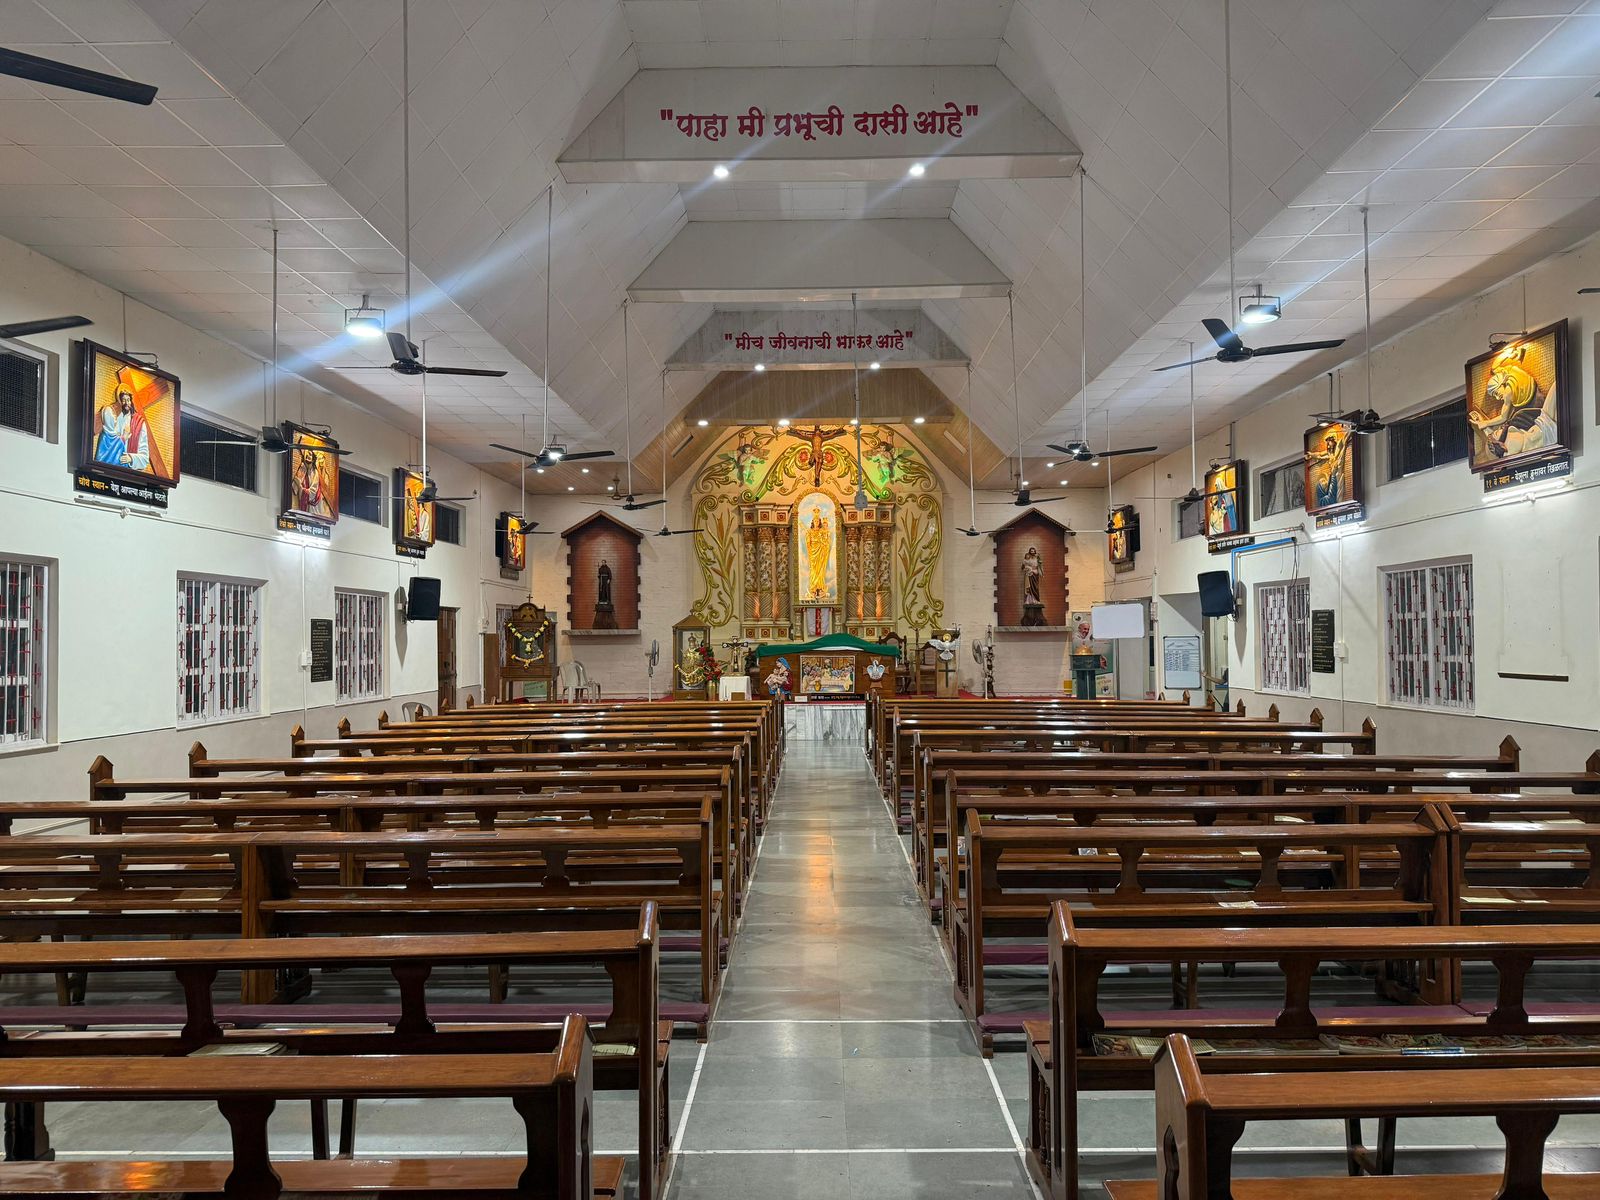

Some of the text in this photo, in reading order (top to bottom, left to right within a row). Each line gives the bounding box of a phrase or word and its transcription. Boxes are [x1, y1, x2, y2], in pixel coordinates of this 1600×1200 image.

[660, 101, 978, 142] "पाहा मी प्रभूची दासी आहे"
[724, 329, 913, 351] "मीच जीवनाची भाकर आहे"
